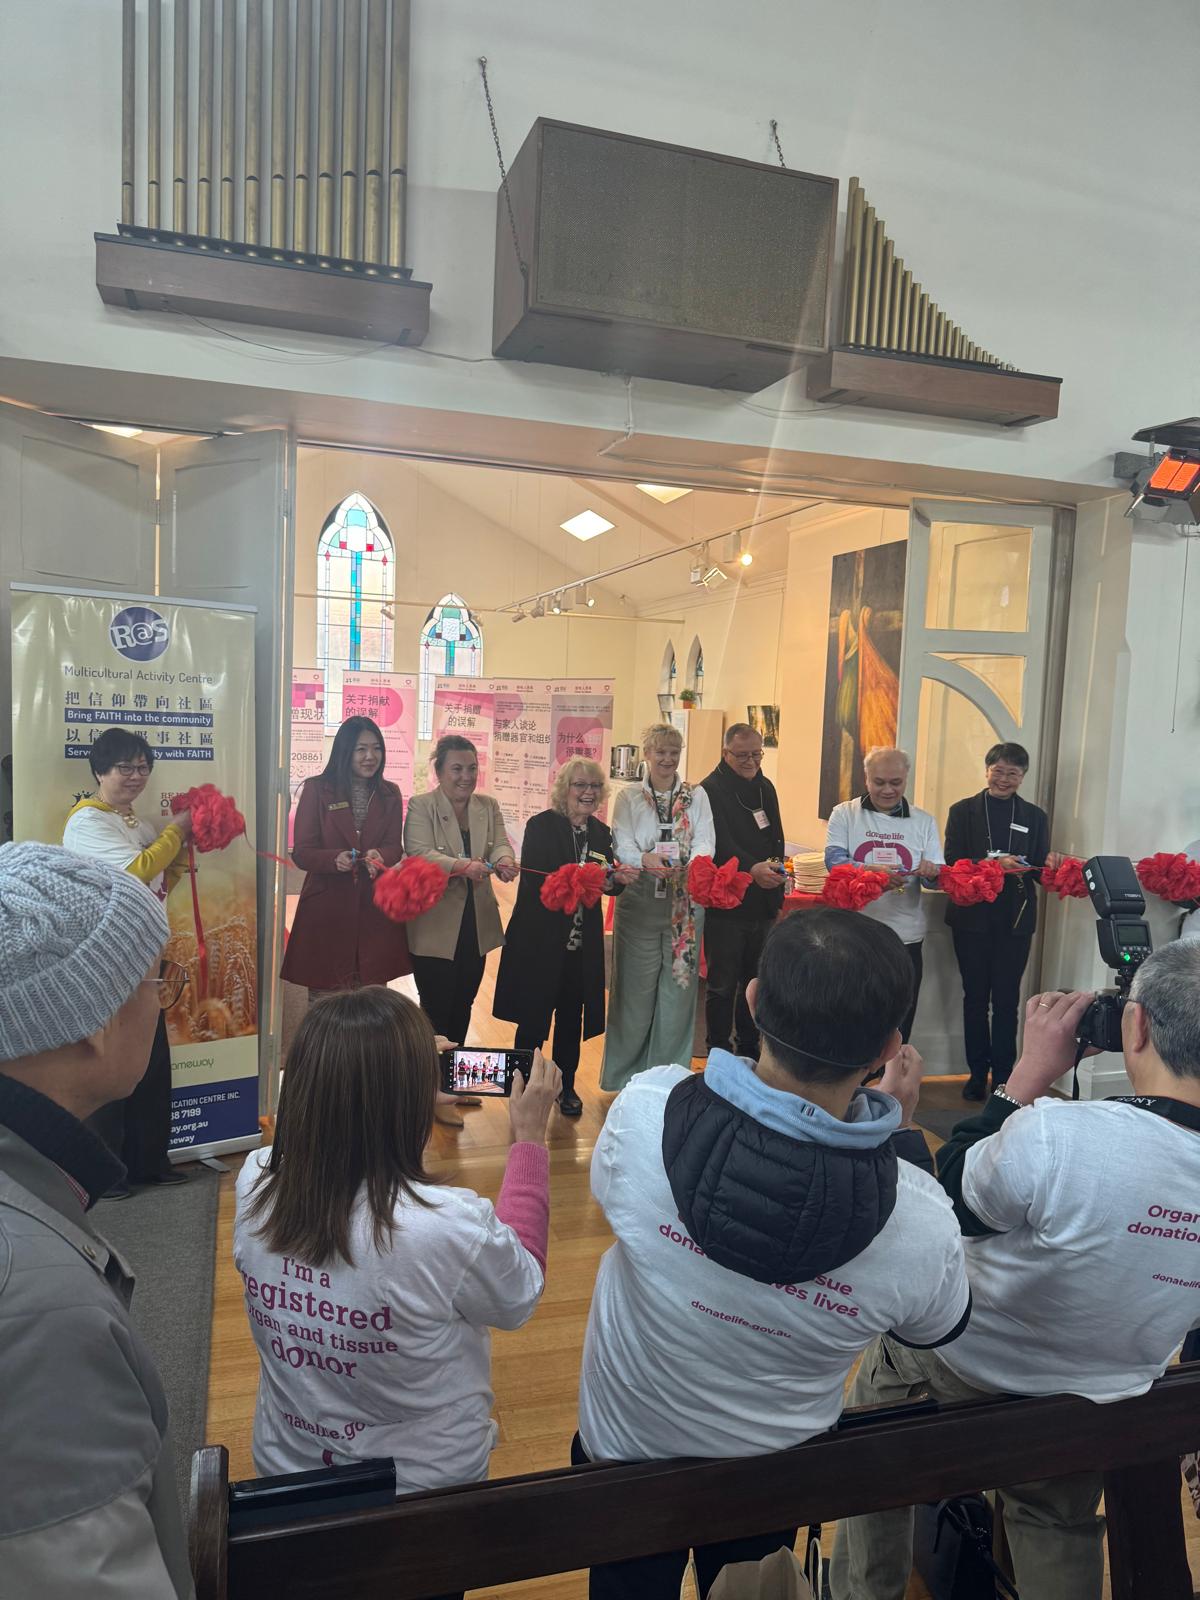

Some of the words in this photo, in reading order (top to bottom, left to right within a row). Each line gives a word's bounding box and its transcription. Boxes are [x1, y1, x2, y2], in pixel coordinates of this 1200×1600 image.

[64, 665, 133, 680] Multicultural
[136, 670, 176, 685] Activity
[178, 672, 213, 685] Centre
[66, 690, 213, 711] 把信仰帶向社區
[67, 710, 92, 722] Bring
[95, 711, 122, 721] FAITH
[124, 713, 142, 723] into
[145, 713, 160, 723] the
[162, 715, 211, 726] community
[165, 749, 185, 759] with
[186, 749, 212, 759] FAITH
[199, 1093, 226, 1104] CENTRE
[282, 1256, 314, 1284] I'm
[319, 1272, 331, 1289] a
[813, 1292, 860, 1318] lives
[691, 1300, 792, 1339] donatelife.gov.au
[288, 1323, 325, 1346] and
[329, 1333, 399, 1354] tissue
[271, 1336, 358, 1380] donor
